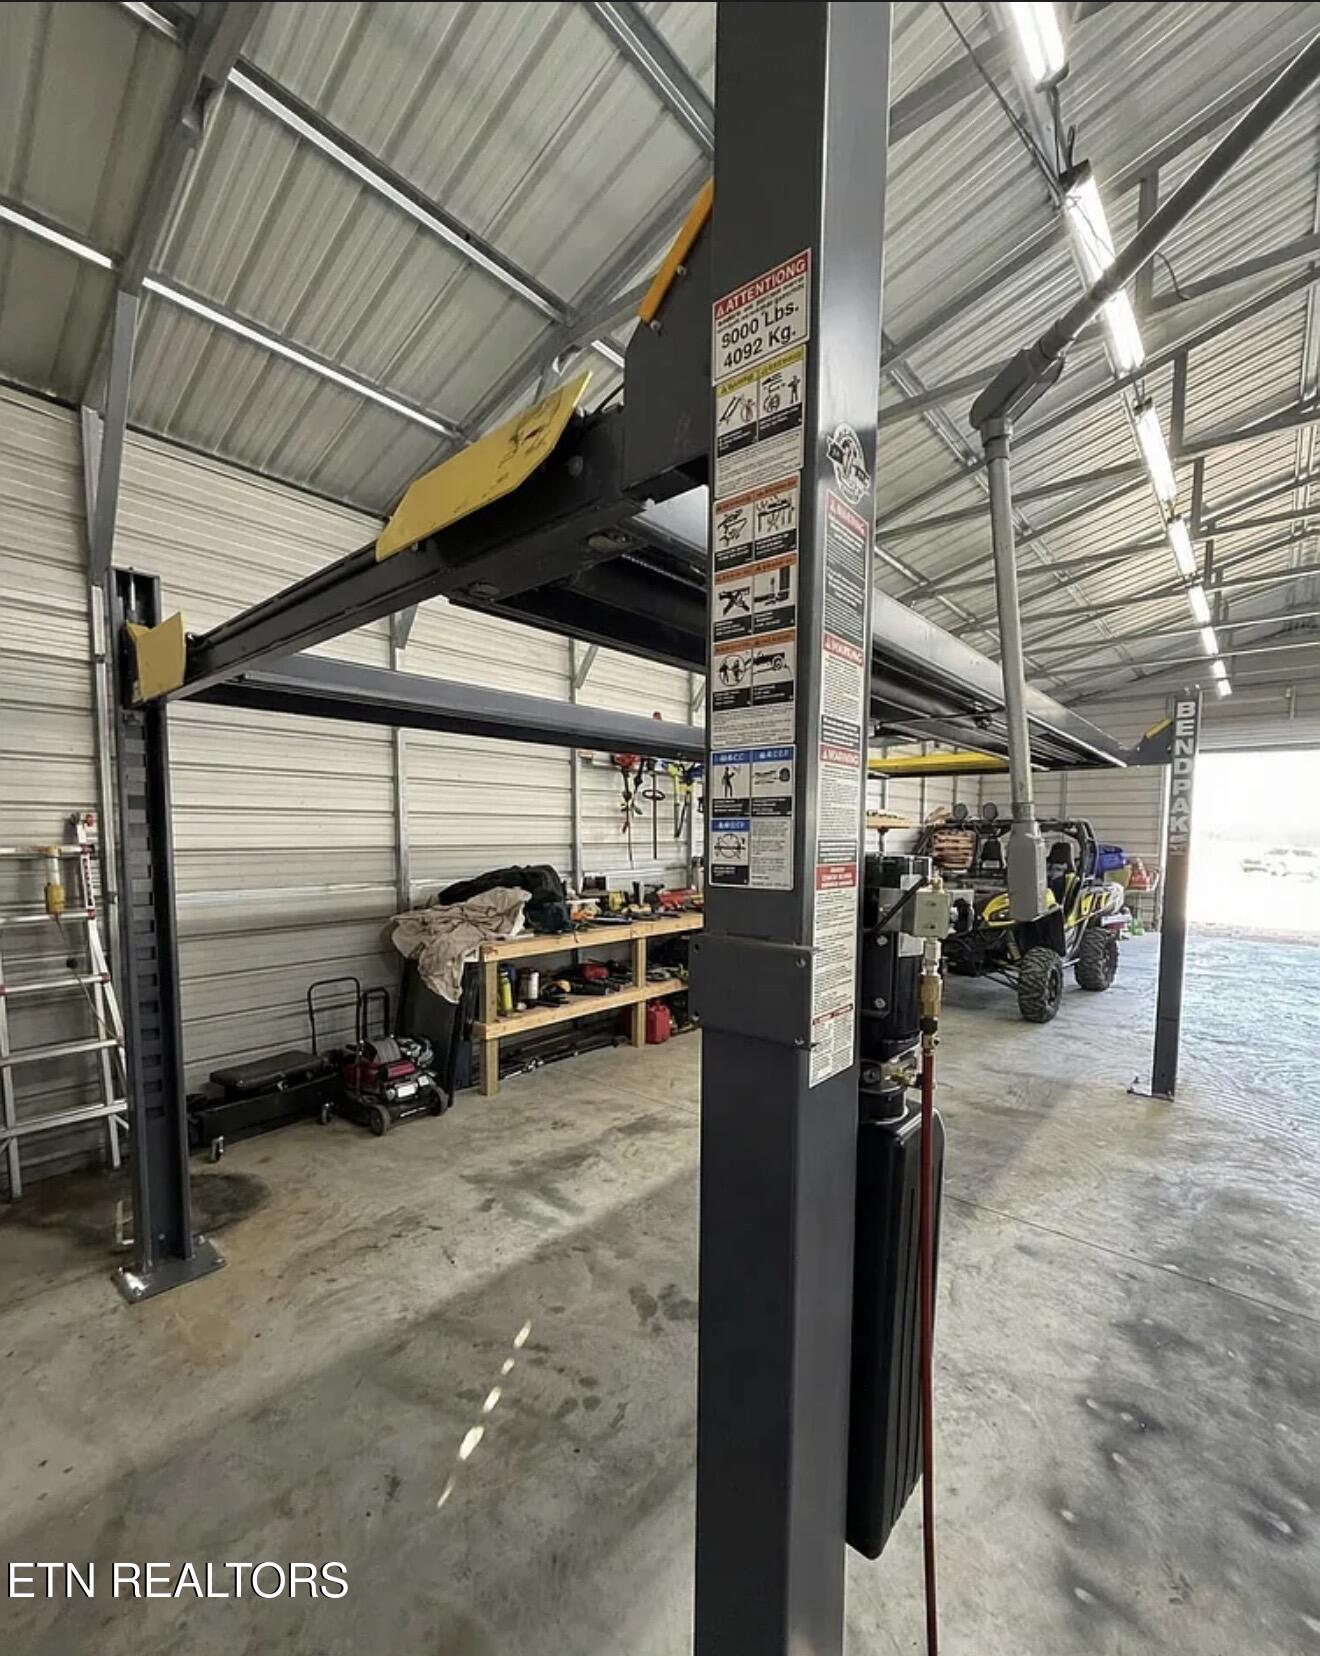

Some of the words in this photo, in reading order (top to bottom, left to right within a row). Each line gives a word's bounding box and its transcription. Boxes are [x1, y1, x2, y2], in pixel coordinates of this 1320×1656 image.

[723, 338, 763, 368] 4092
[768, 324, 796, 347] Kg.
[1170, 701, 1196, 832] BENDPAK
